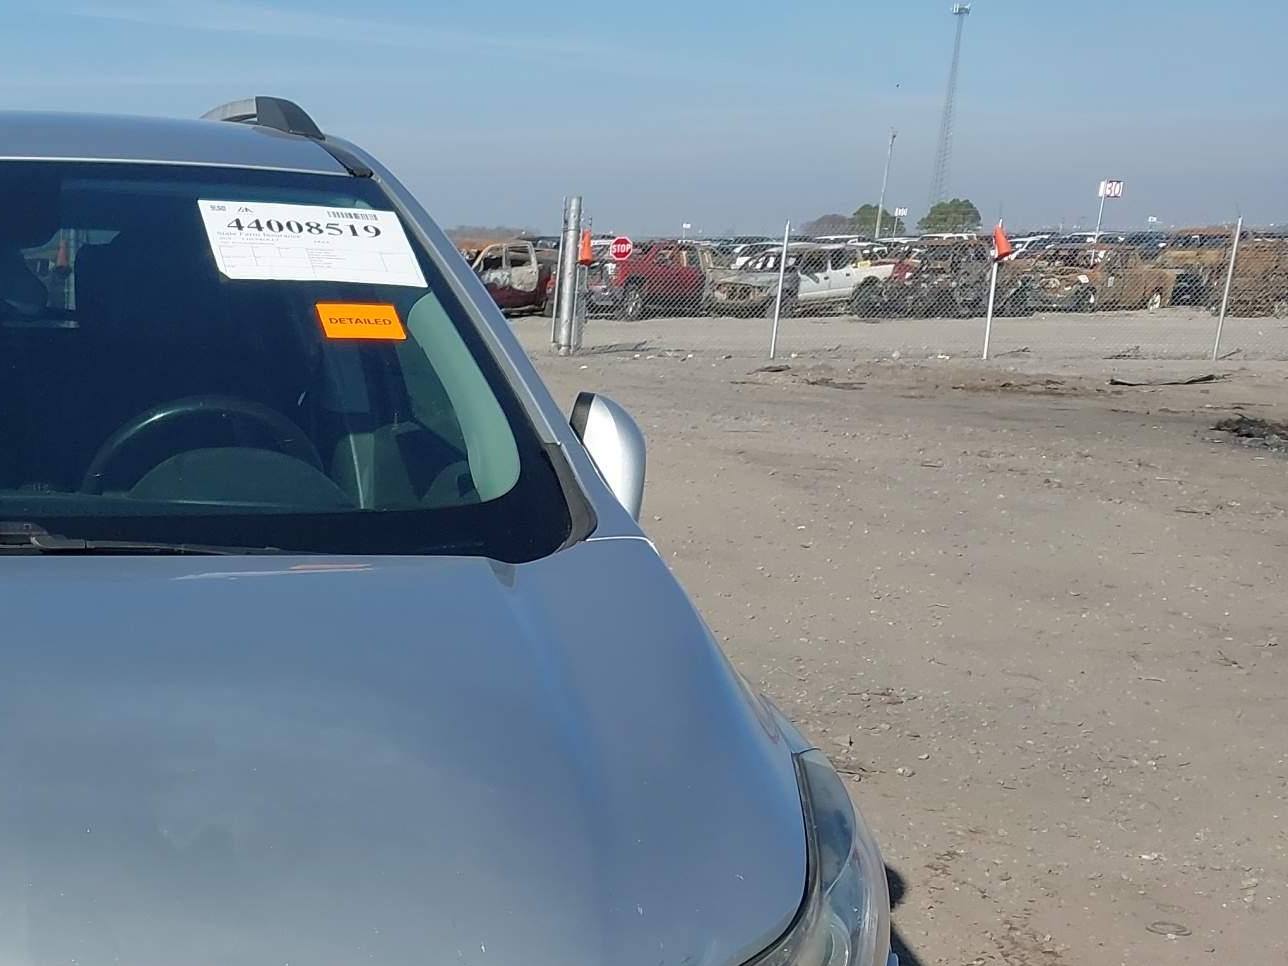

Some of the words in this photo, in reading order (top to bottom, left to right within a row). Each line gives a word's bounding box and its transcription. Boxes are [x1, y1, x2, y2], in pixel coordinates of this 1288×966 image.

[227, 217, 381, 239] 44008519
[612, 243, 631, 254] STOP
[328, 317, 393, 326] DETAILED
